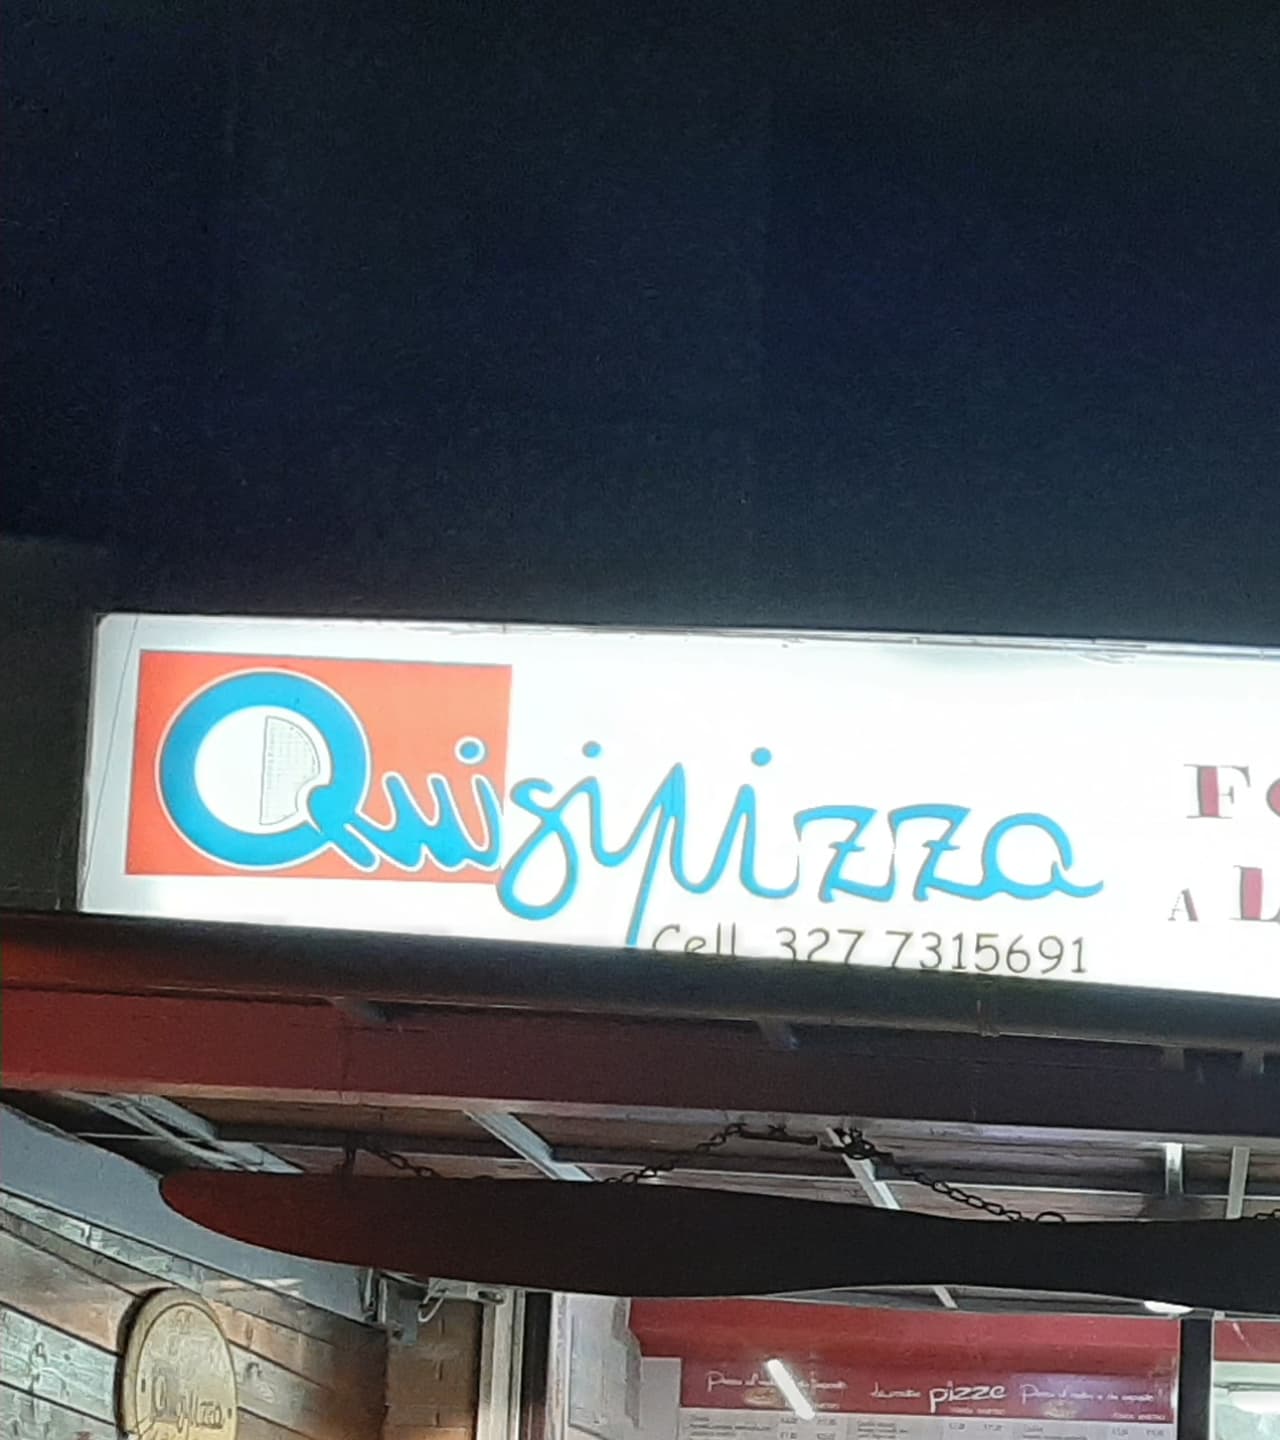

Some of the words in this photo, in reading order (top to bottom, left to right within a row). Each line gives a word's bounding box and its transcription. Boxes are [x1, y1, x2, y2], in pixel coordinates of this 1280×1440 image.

[1167, 887, 1199, 922] A
[775, 927, 866, 962] 327
[884, 929, 1088, 975] 7315691
[929, 1380, 1007, 1413] pizze
